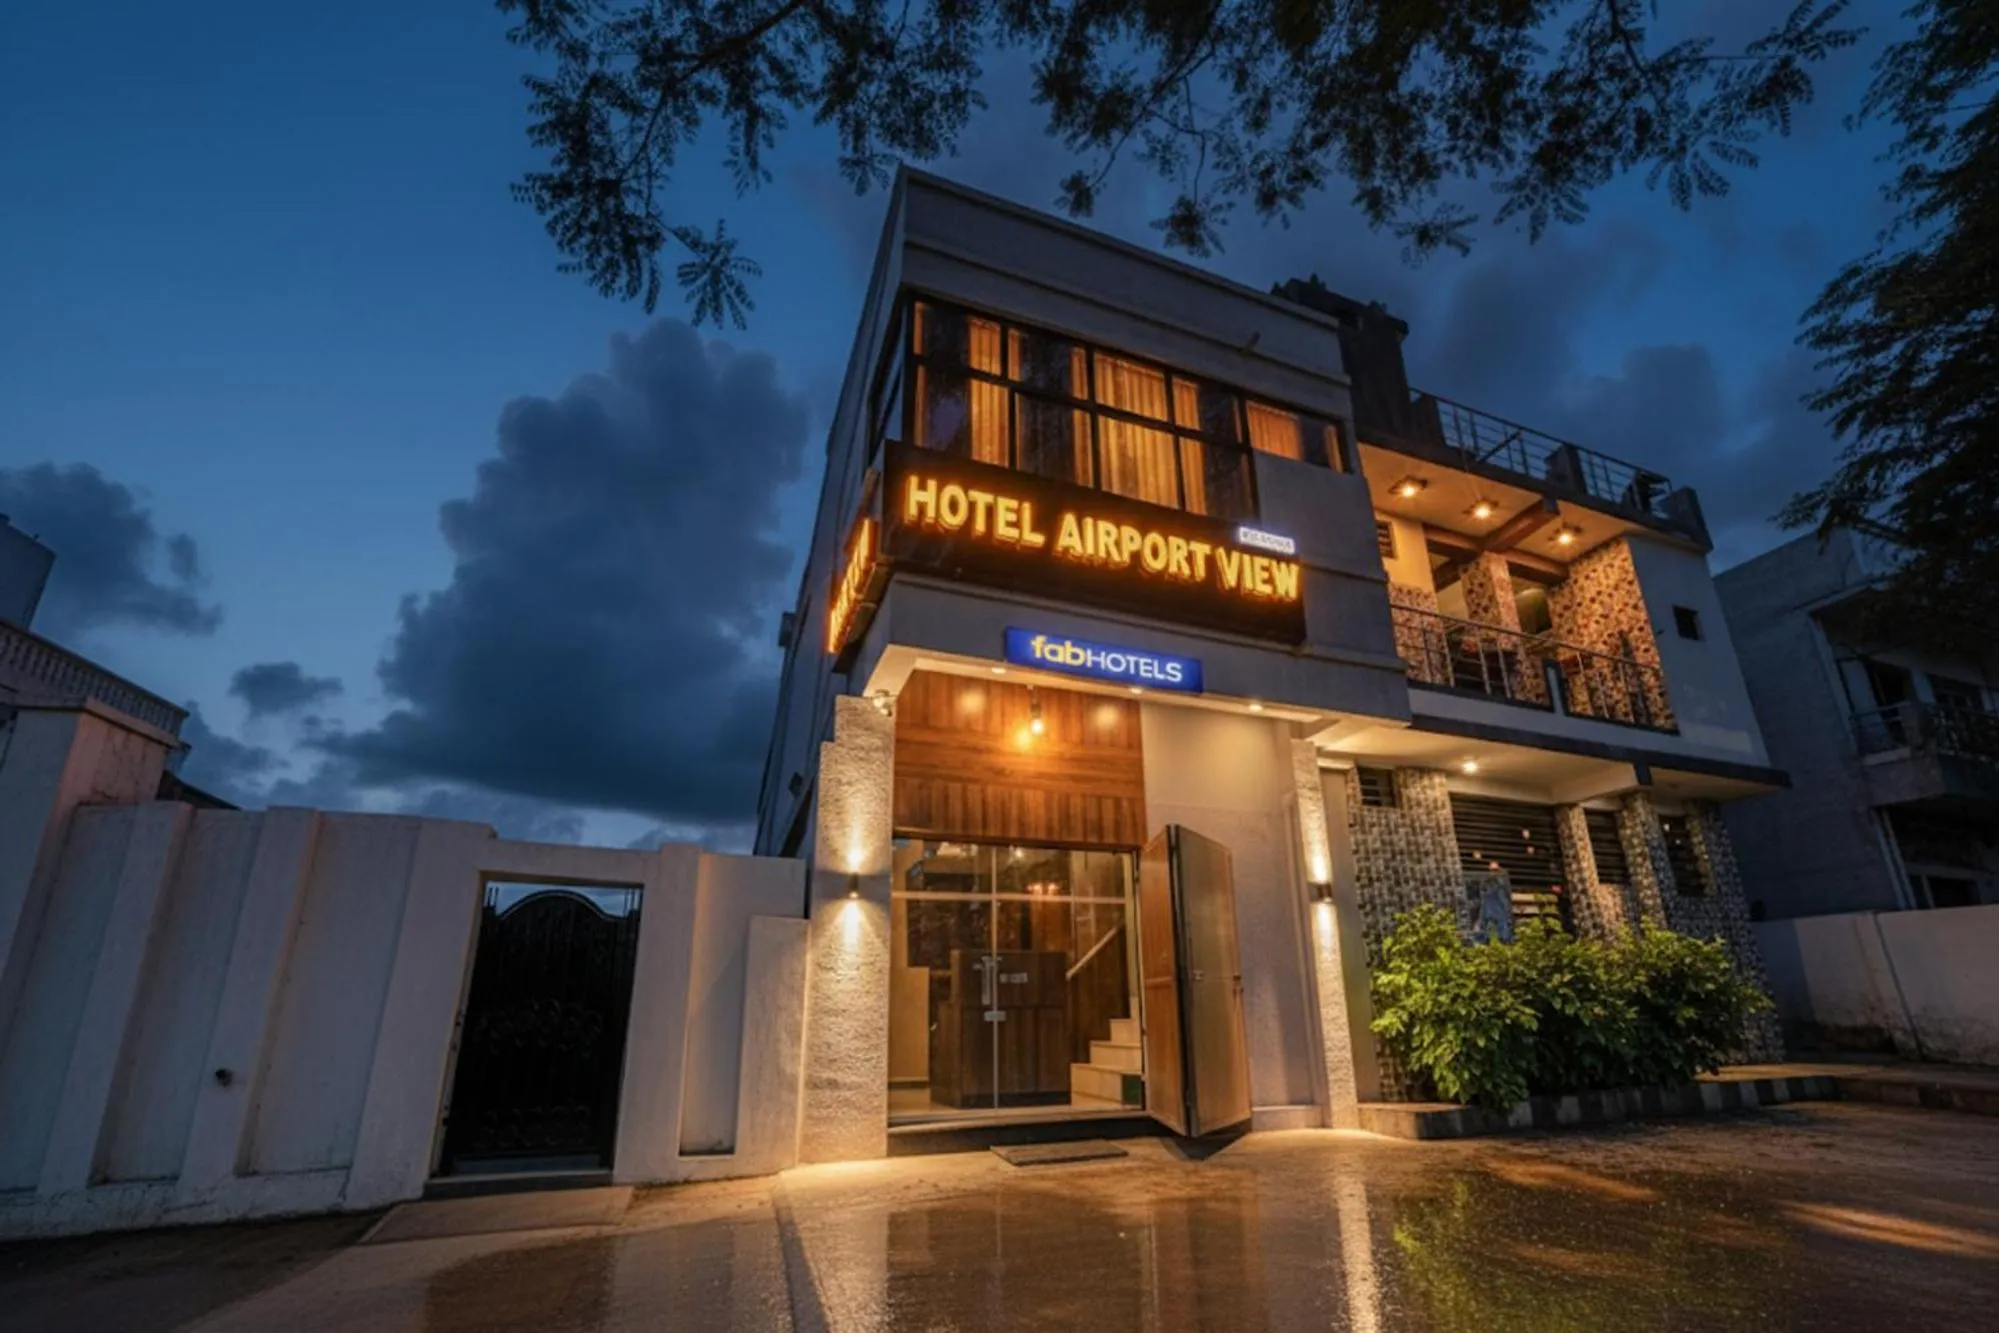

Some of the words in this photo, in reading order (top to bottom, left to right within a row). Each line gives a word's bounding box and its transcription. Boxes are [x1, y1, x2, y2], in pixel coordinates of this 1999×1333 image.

[906, 475, 1044, 547] HOTEL
[1058, 513, 1212, 580] AIRPORT
[1216, 548, 1299, 600] VIEW
[1032, 635, 1182, 682] fabHOTELS
